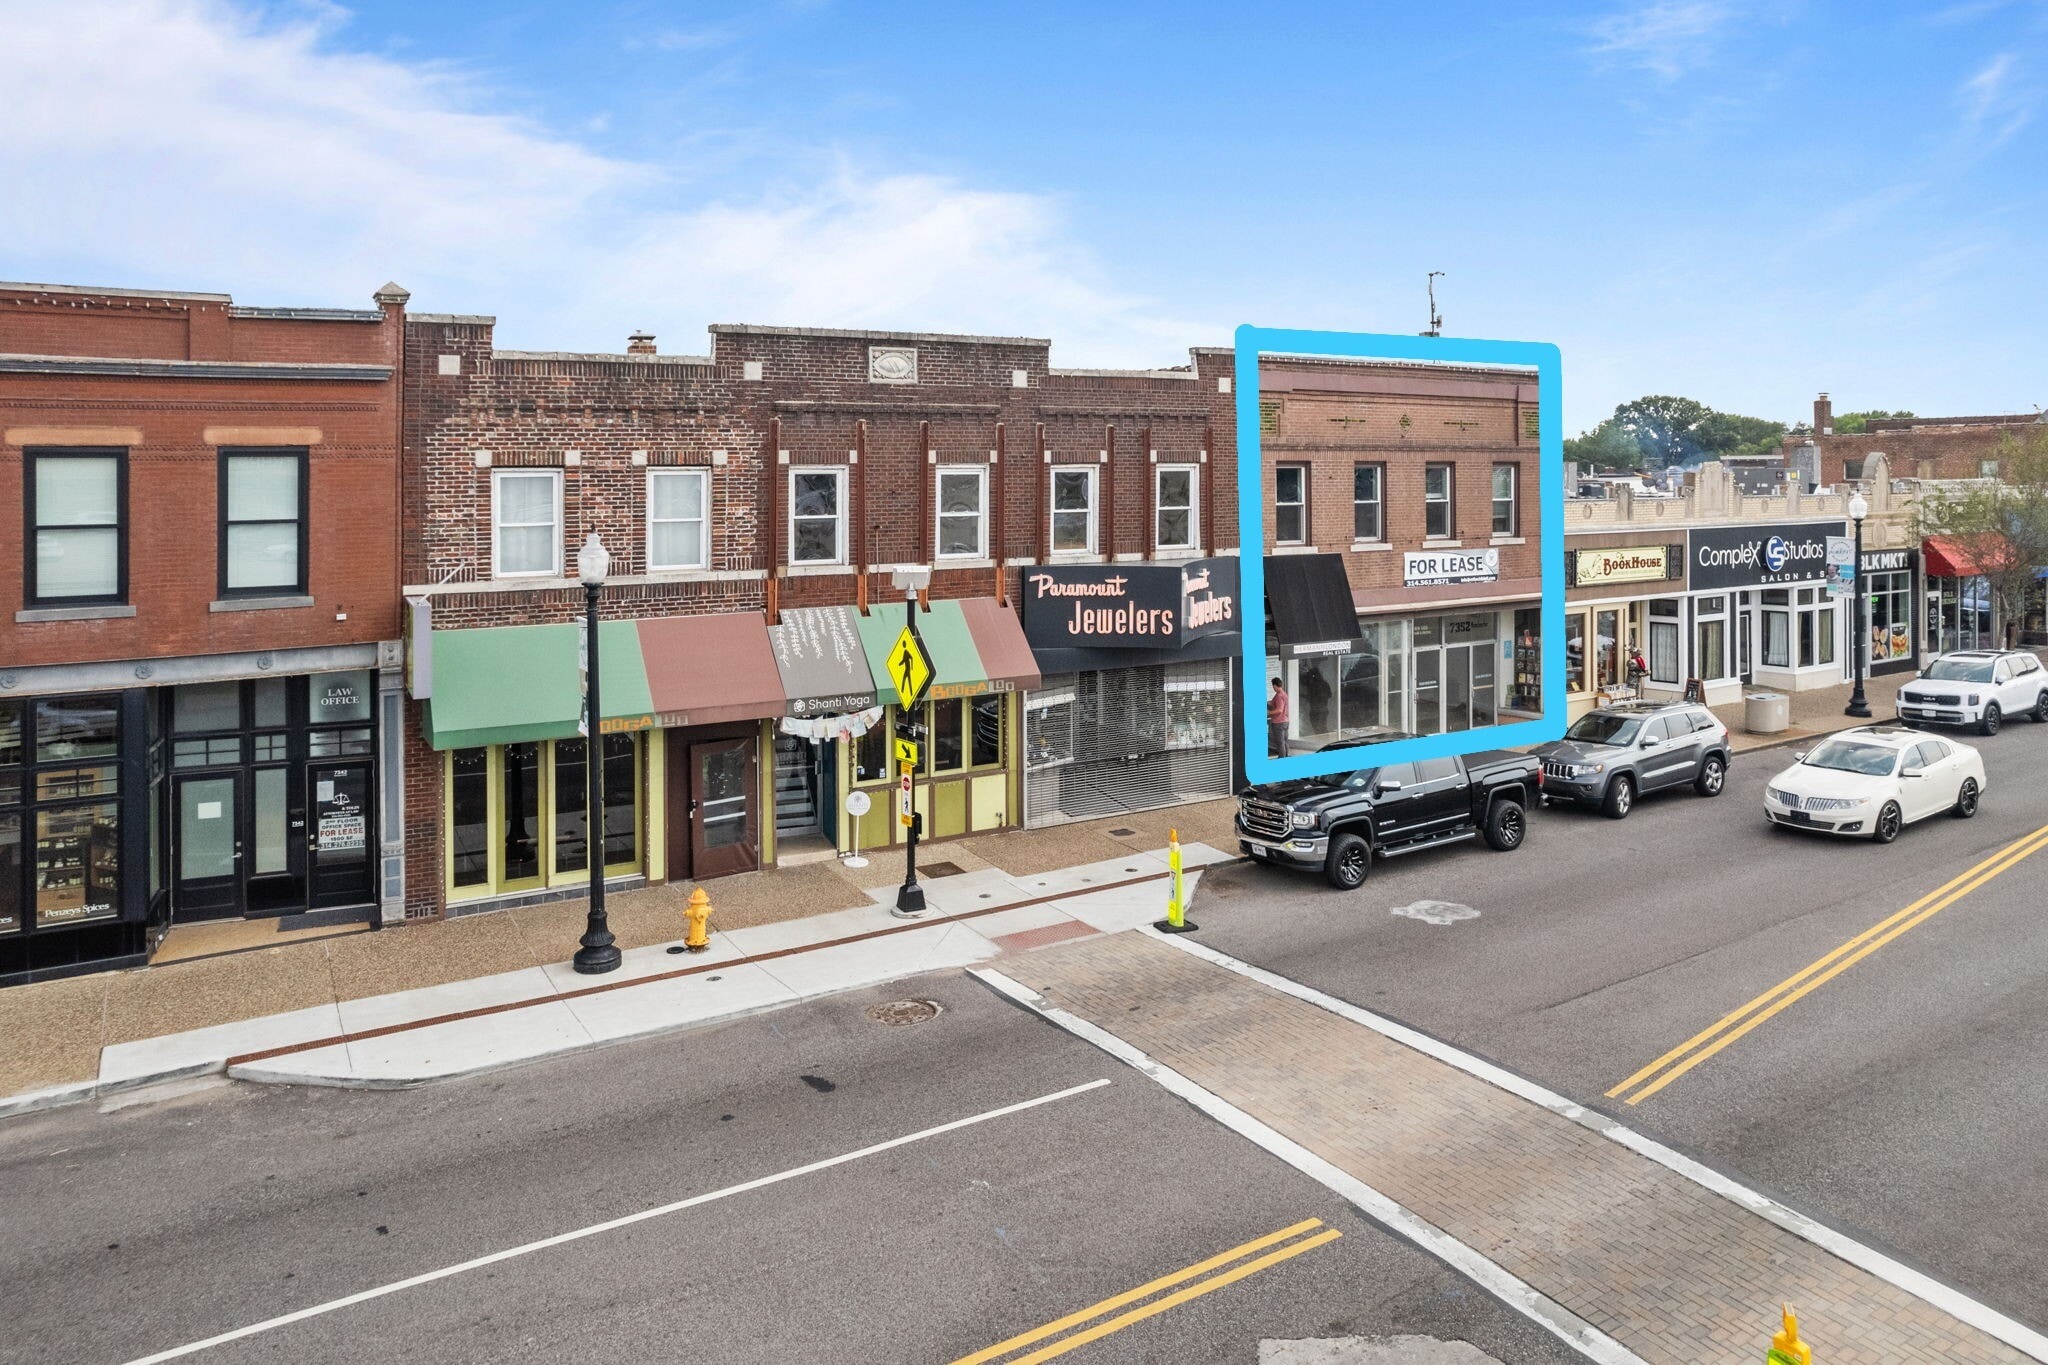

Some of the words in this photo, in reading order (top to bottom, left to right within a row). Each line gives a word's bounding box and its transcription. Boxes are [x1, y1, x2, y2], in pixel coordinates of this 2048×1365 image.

[1783, 539, 1824, 561] Studios
[1409, 559, 1438, 575] FOR
[1441, 556, 1484, 573] LEASE
[1881, 552, 1905, 569] MKT
[1761, 573, 1799, 583] SALON
[1807, 571, 1812, 579] &
[1029, 573, 1129, 599] Paramount
[1068, 600, 1174, 635] Jewelers
[1450, 621, 1471, 633] 7352
[328, 687, 353, 697] LAW
[320, 696, 360, 706] OFFICE
[808, 699, 841, 709] Shanti
[844, 696, 870, 707] Yoga
[320, 830, 336, 838] FOR
[338, 828, 364, 836] LEASE
[45, 907, 81, 917] Penzeys
[82, 903, 110, 913] Spices
